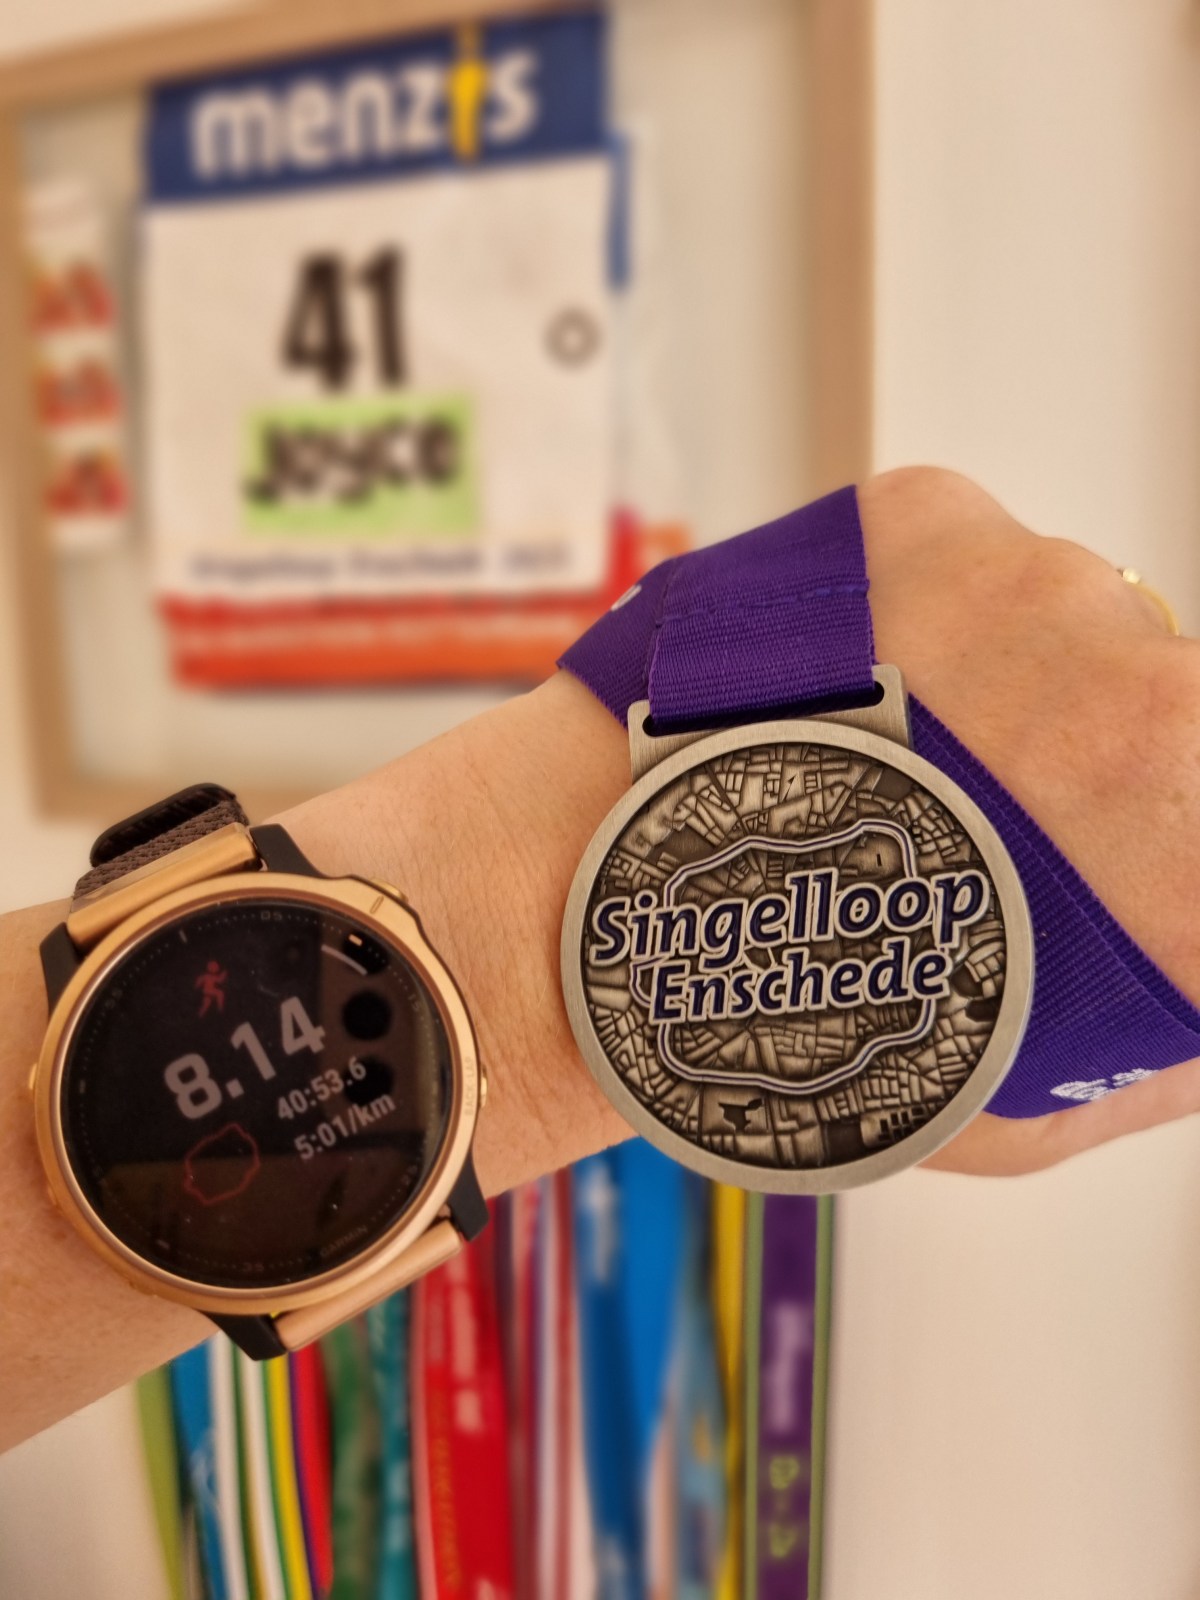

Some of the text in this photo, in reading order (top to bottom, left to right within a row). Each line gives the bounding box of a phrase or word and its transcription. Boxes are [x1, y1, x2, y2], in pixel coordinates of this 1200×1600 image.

[281, 244, 407, 392] 41
[590, 868, 989, 970] Singelloop
[649, 936, 952, 1024] Enschede
[163, 996, 326, 1119] 8.14
[278, 1057, 367, 1119] 40:53.6
[294, 1095, 396, 1160] 5:01/km
